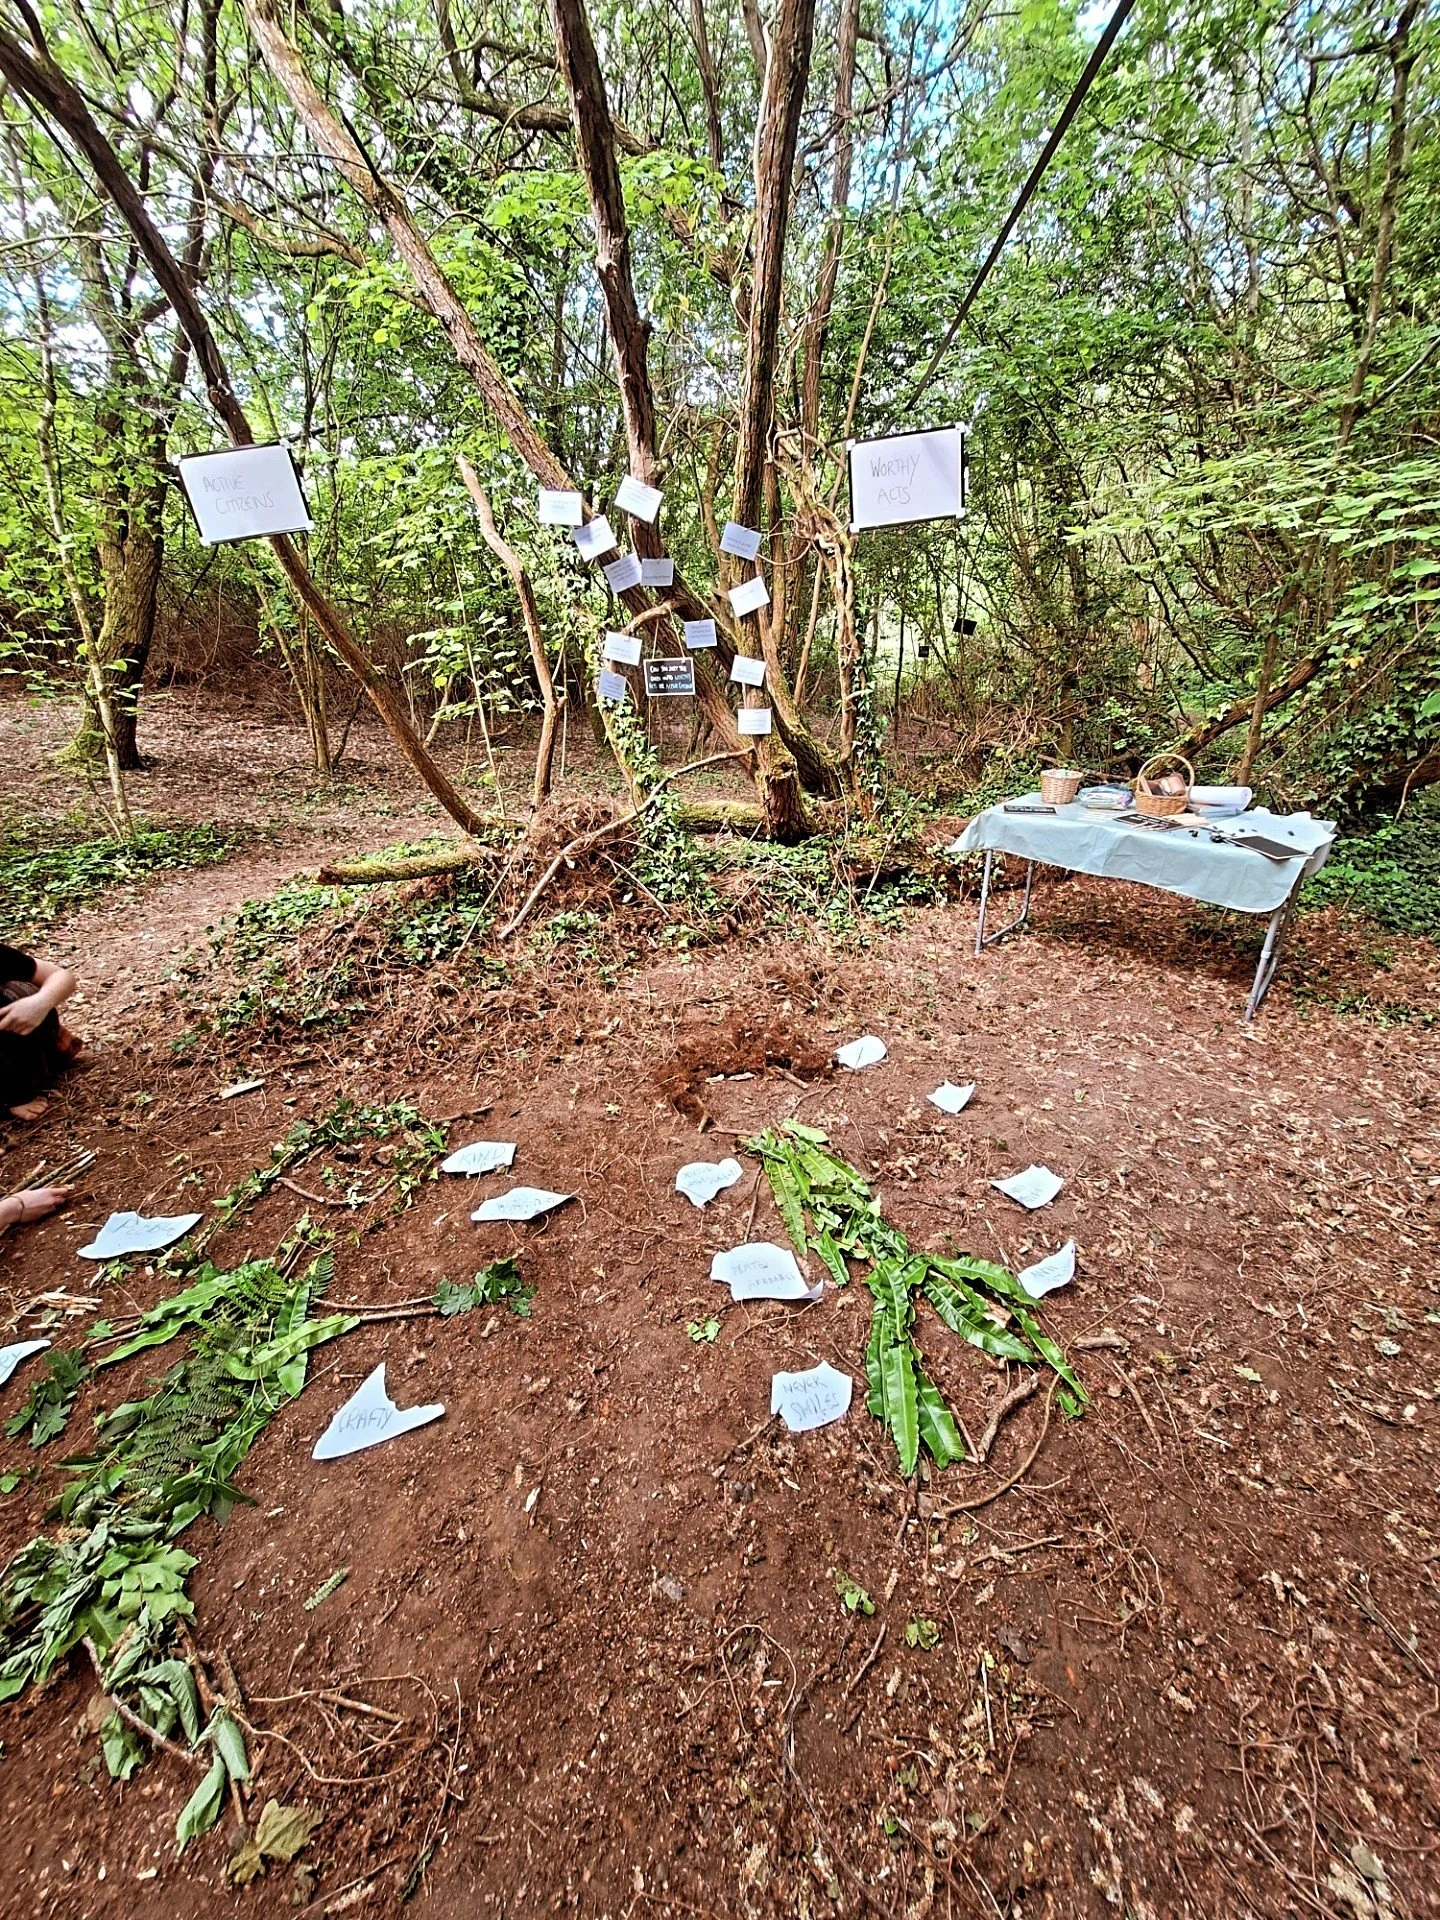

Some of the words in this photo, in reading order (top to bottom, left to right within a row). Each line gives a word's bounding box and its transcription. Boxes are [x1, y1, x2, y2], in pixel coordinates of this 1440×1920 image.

[870, 454, 920, 485] WORTHY
[203, 475, 245, 492] ACTIVE
[215, 491, 275, 515] CITIZENS
[878, 486, 910, 505] ACTS
[458, 1145, 506, 1165] KIND
[782, 1376, 828, 1393] NEVER
[339, 1407, 393, 1432] CRAFTY
